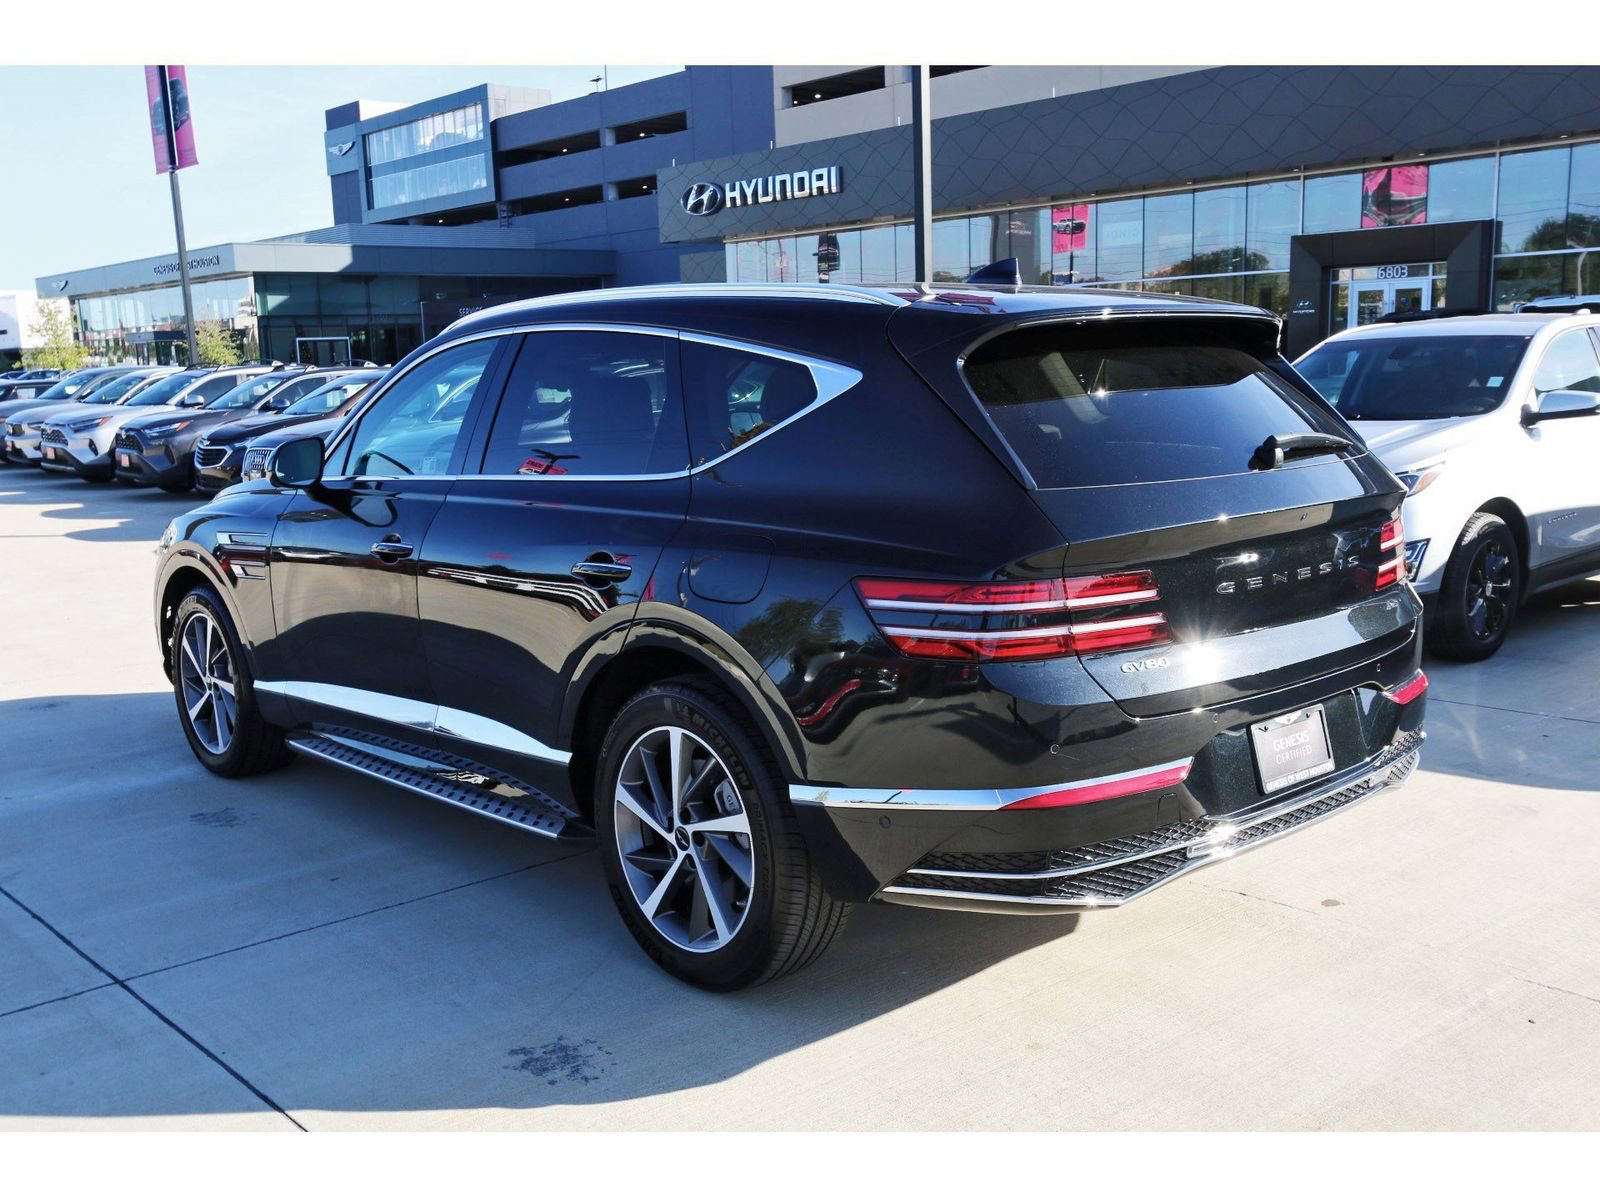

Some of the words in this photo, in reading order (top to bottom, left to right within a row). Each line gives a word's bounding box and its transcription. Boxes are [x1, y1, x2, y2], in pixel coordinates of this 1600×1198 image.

[725, 166, 840, 208] HYUNDAI
[1377, 265, 1408, 279] 6803
[1216, 555, 1360, 595] GENESIS
[1120, 656, 1169, 674] GV80
[692, 712, 751, 787] MICHELIN
[1273, 731, 1310, 752] GENESIS
[1276, 744, 1312, 765] CERTIFIED
[1265, 776, 1288, 792] GENESIS
[1287, 774, 1296, 785] OF
[1295, 769, 1310, 782] WEST
